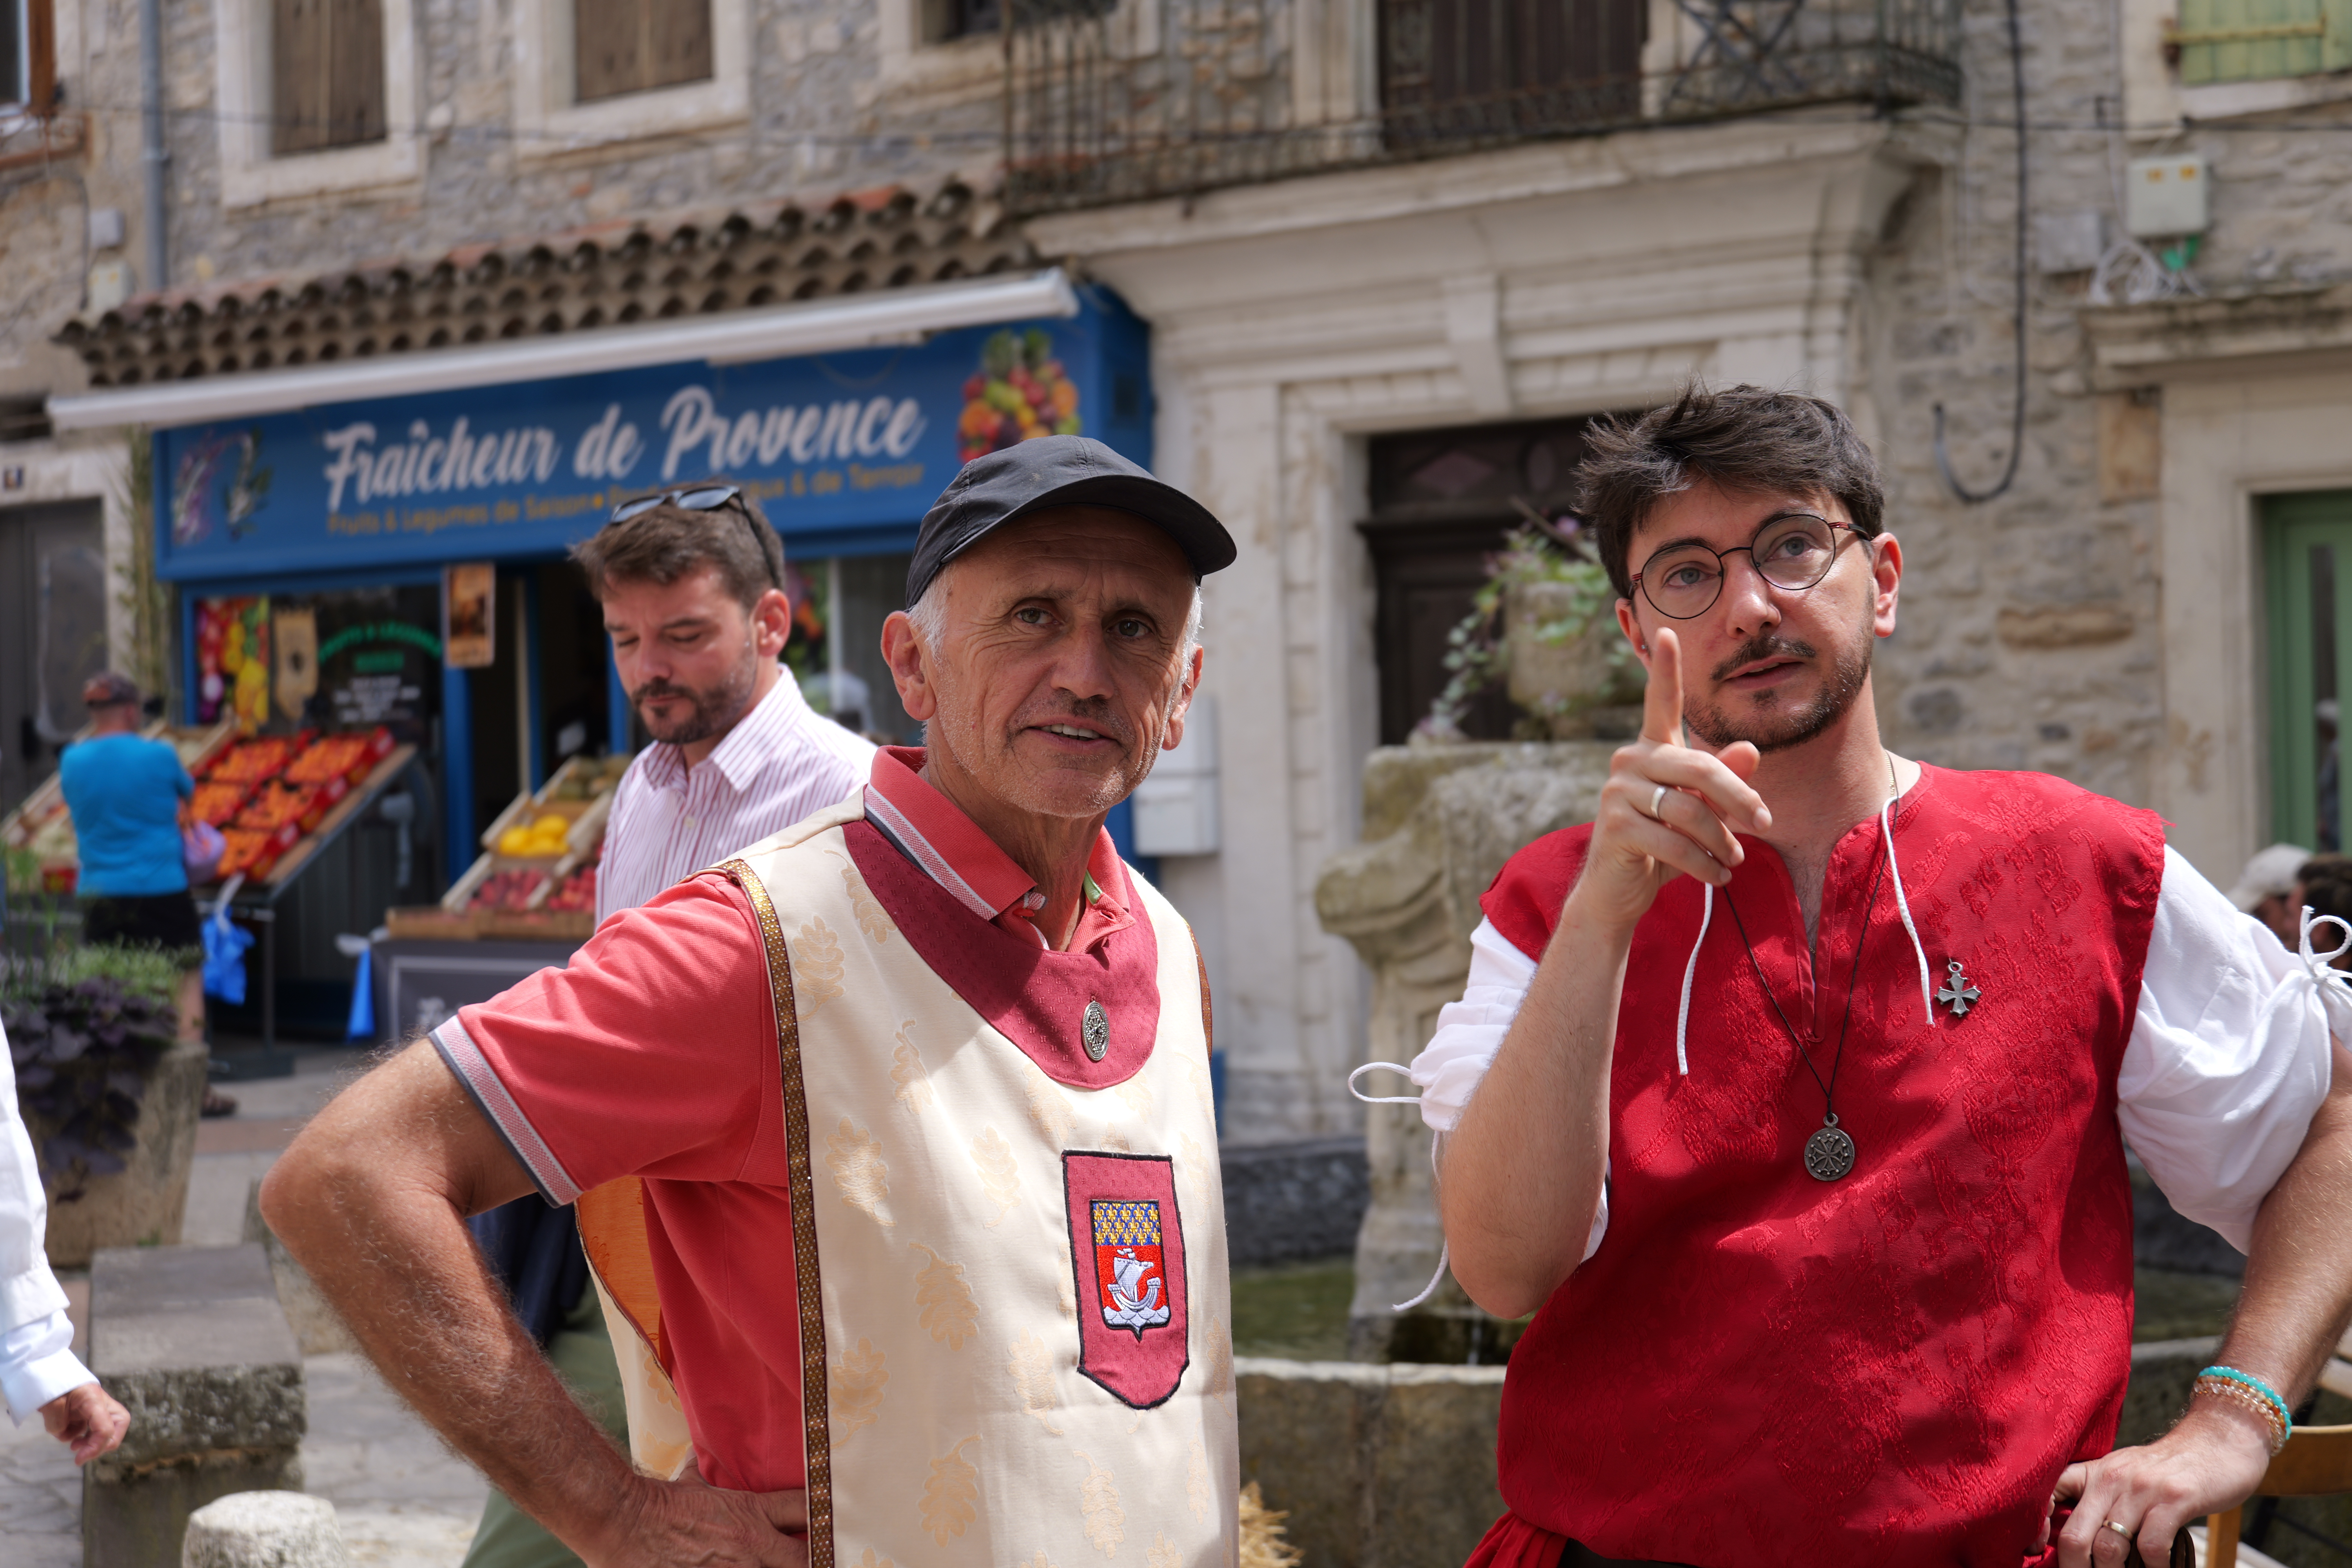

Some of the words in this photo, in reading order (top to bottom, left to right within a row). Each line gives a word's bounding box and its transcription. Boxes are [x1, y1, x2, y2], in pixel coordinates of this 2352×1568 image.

[324, 415, 562, 513] Fraîcheur
[573, 402, 646, 479] de
[661, 385, 928, 480] Provence
[811, 468, 842, 495] de
[494, 500, 519, 524] de
